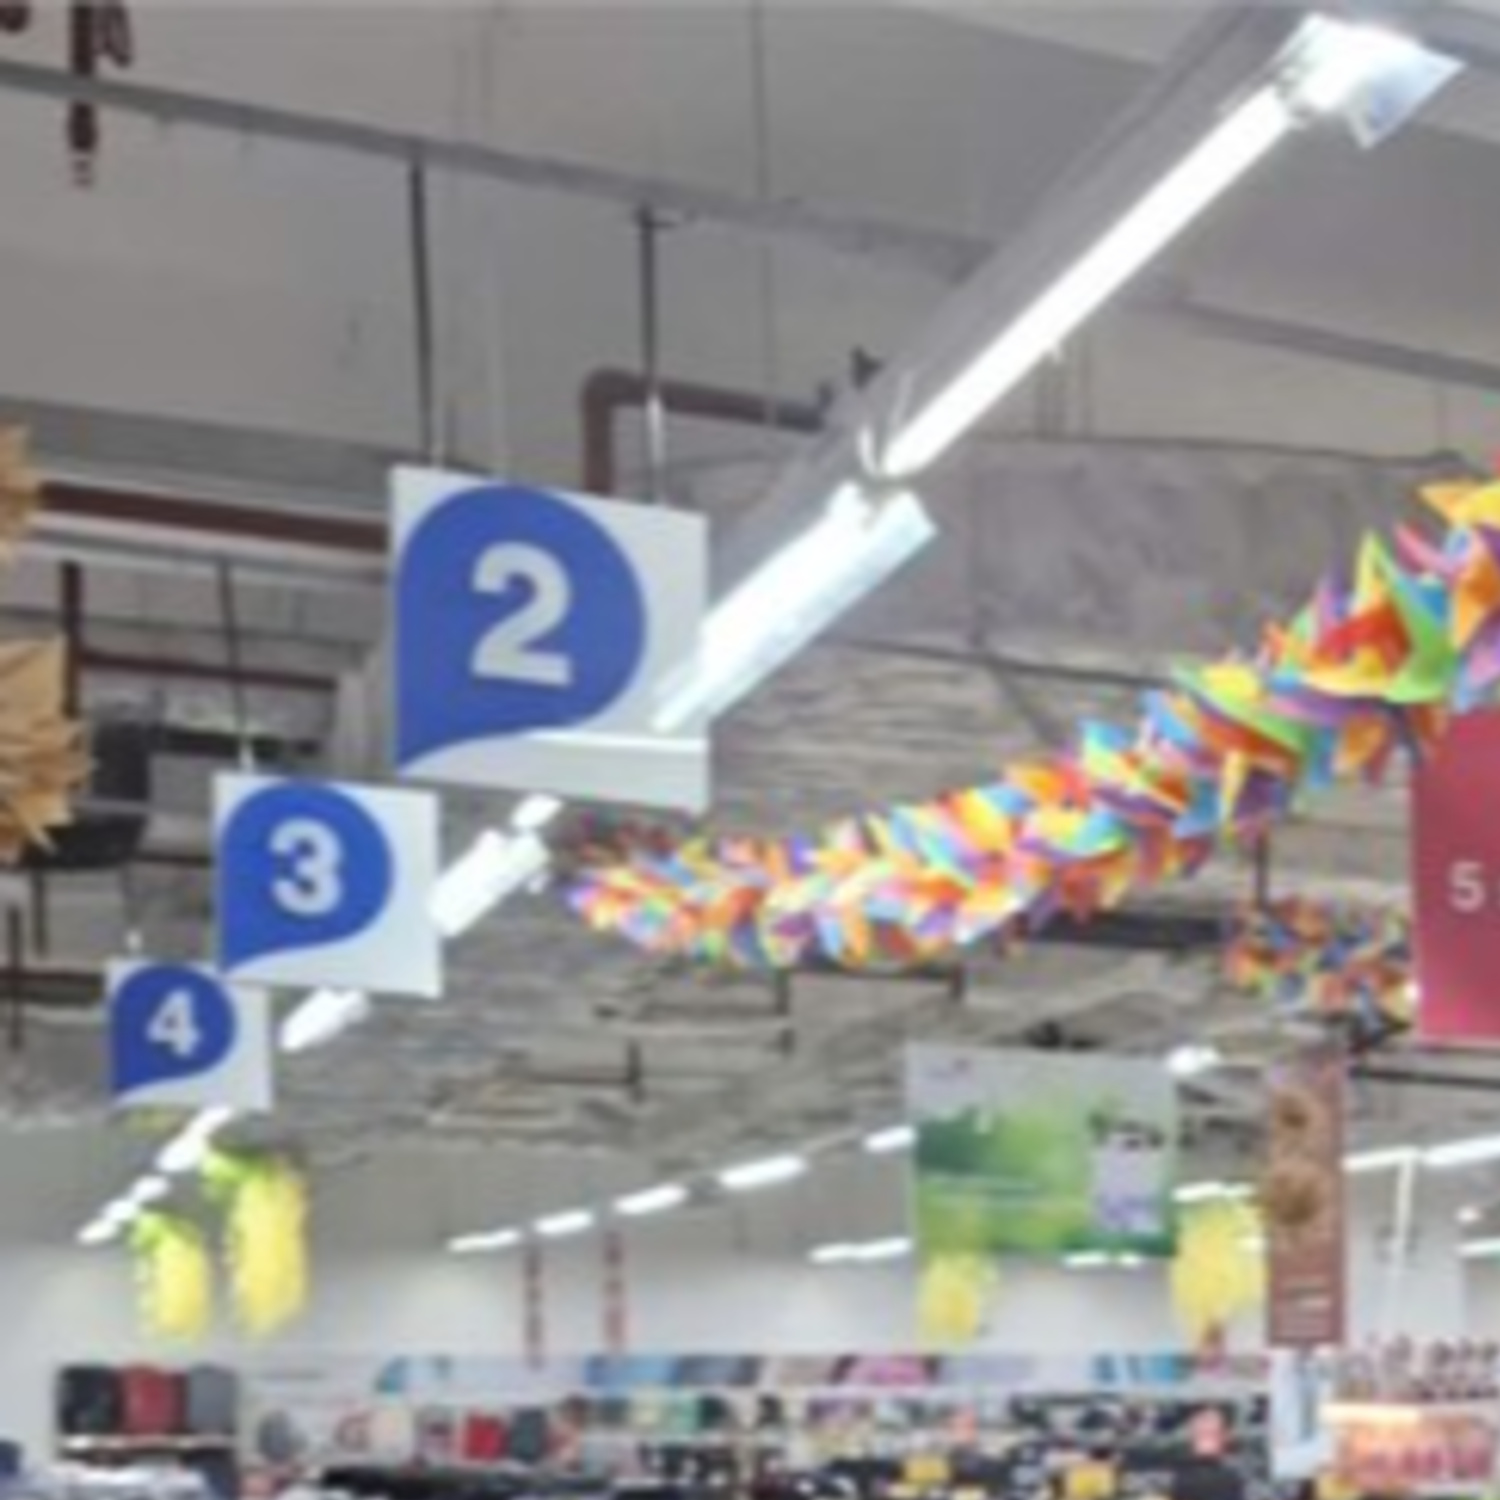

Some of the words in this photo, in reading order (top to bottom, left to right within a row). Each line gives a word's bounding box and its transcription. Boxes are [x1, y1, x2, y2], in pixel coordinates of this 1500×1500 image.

[470, 541, 574, 687] 2
[269, 819, 344, 915] 3
[1449, 862, 1486, 912] 5
[147, 990, 202, 1056] 4
